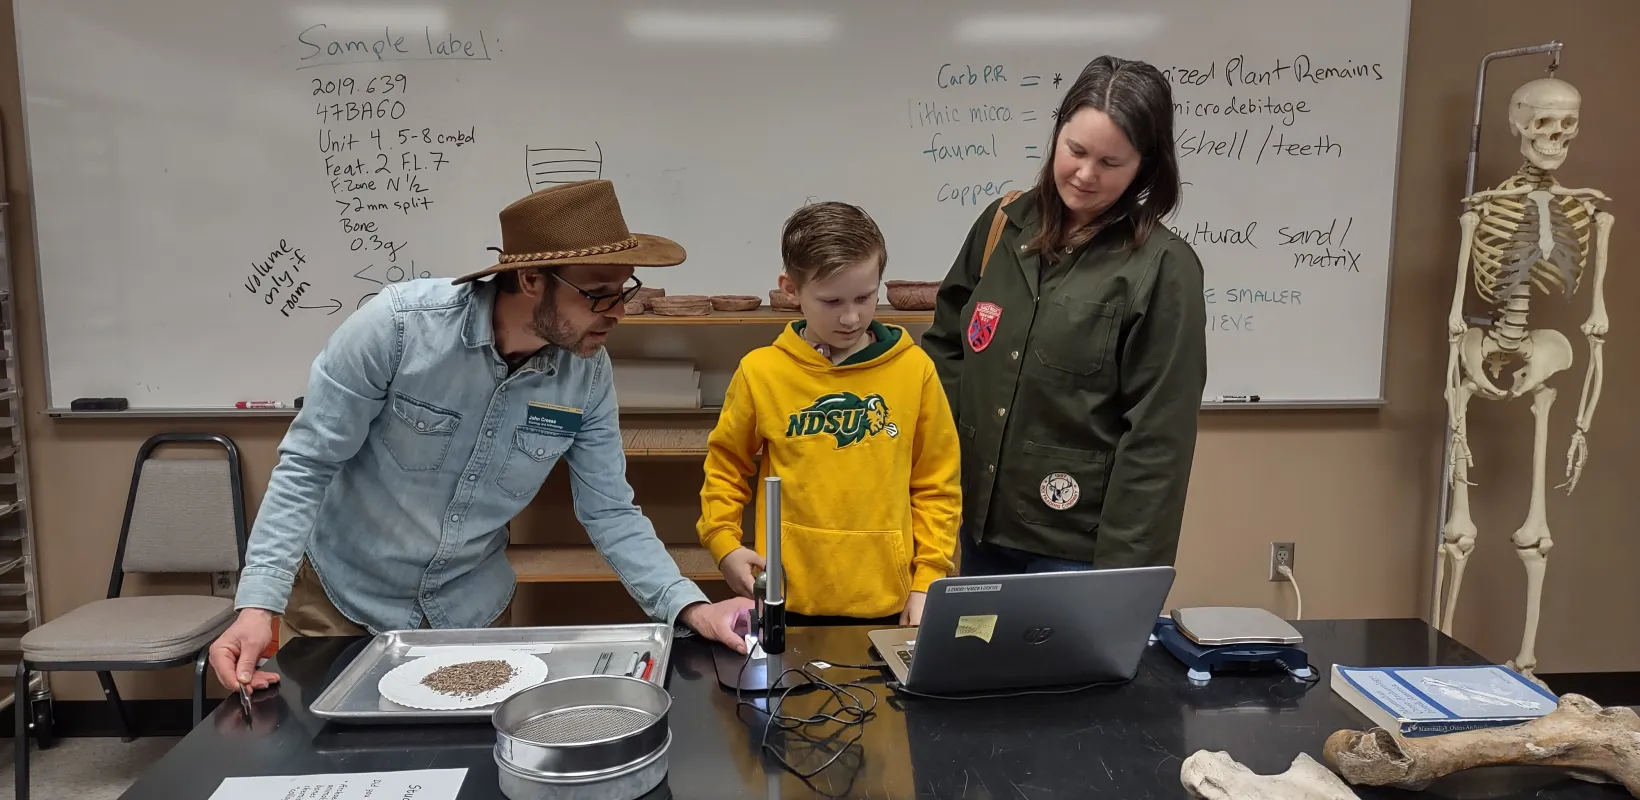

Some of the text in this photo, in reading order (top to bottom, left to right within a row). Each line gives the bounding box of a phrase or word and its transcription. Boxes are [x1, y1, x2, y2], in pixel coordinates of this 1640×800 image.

[298, 24, 409, 60] Sample
[311, 74, 407, 96] 2019.639
[937, 63, 978, 89] Carb
[1161, 61, 1214, 86] nized
[1225, 55, 1291, 87] Plant
[1293, 55, 1384, 84] Remains
[907, 98, 961, 129] lithic
[319, 128, 360, 153] Unit
[398, 127, 432, 145] 5-8
[324, 154, 369, 176] Feat.
[374, 153, 392, 174] 2
[429, 151, 450, 172] 7
[386, 177, 400, 192] N
[393, 196, 434, 215] split
[339, 217, 379, 234] Bone
[1169, 220, 1259, 249] ultural
[1293, 248, 1362, 274] matrix
[264, 248, 306, 305] only if
[280, 281, 311, 318] room
[1203, 287, 1302, 305] E SMALLER
[1211, 313, 1256, 332] IEVE
[784, 409, 866, 437] NDSU
